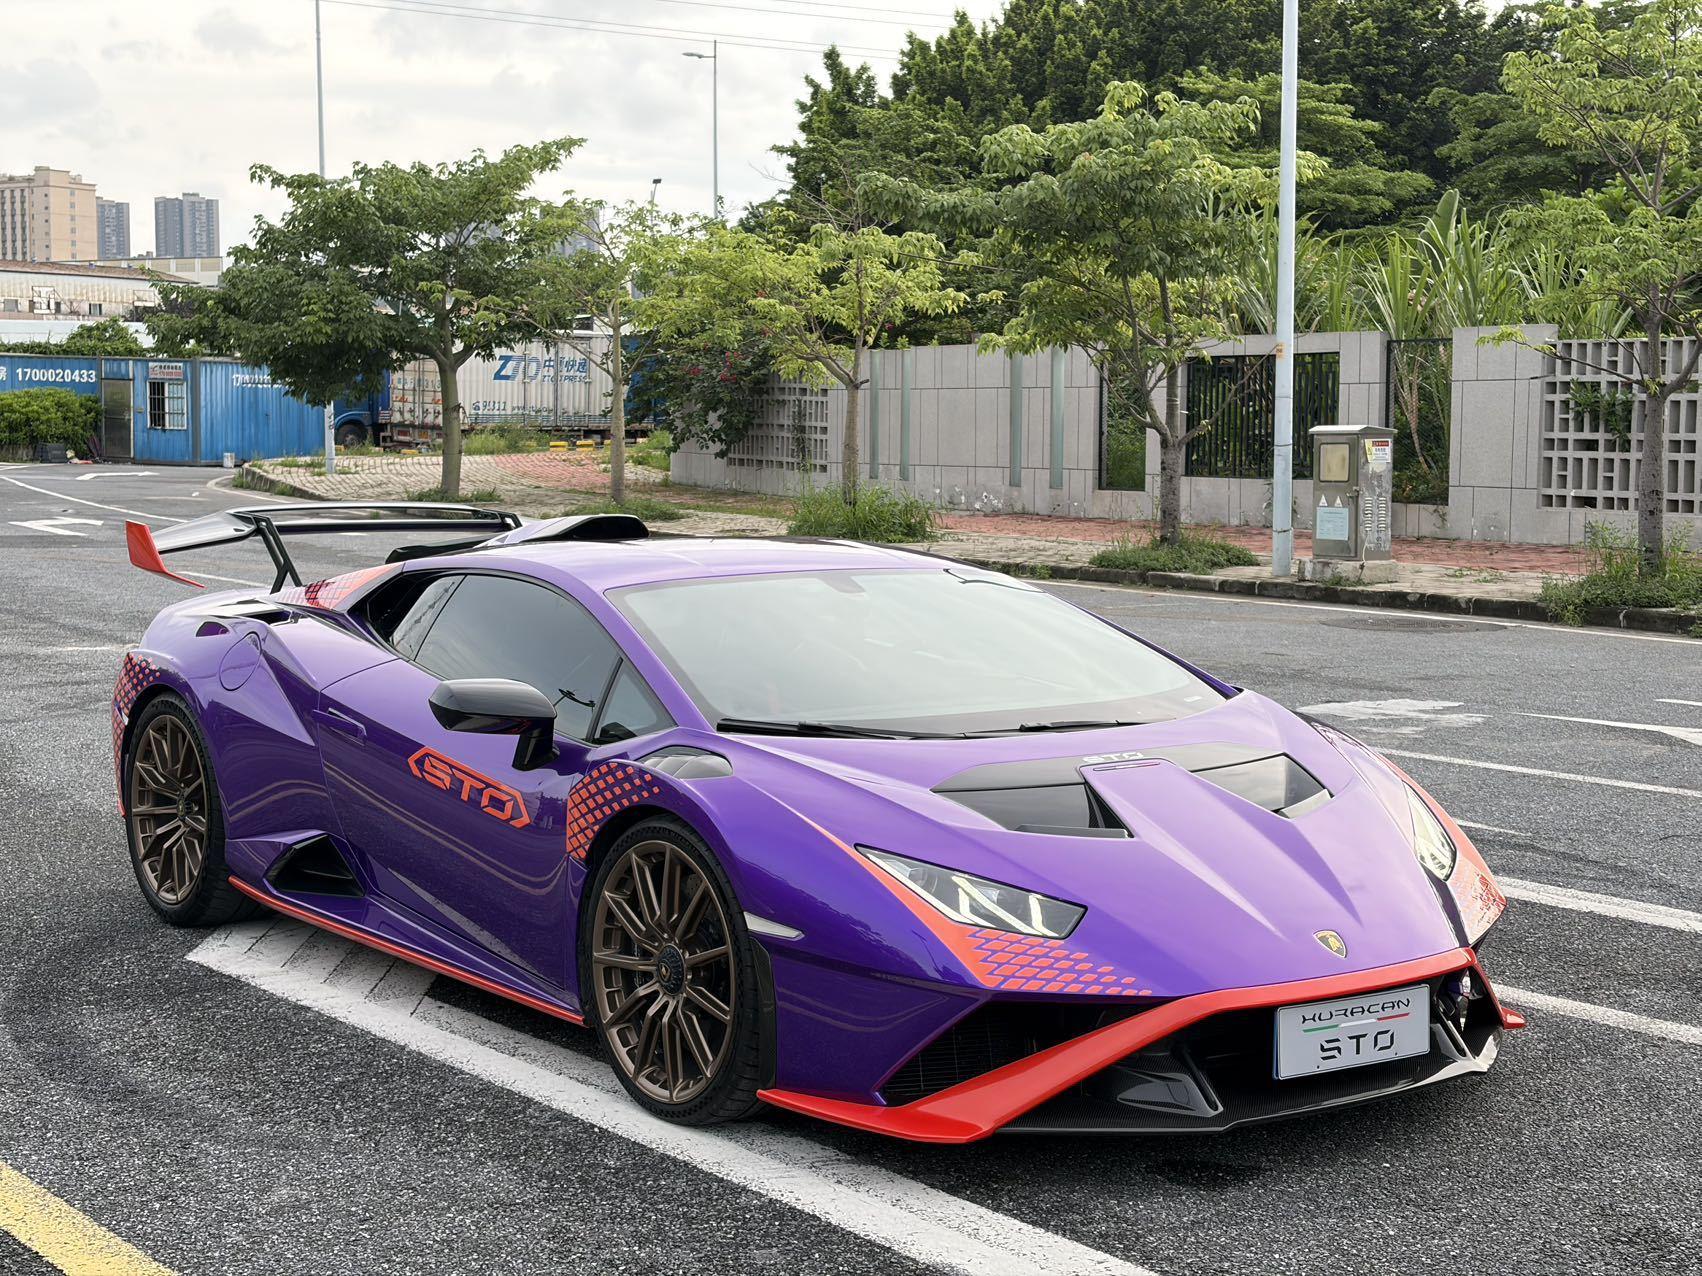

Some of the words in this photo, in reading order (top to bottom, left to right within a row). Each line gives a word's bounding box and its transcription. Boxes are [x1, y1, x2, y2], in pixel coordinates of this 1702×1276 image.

[16, 368, 96, 382] 1700020433
[493, 355, 542, 381] ZTO
[1083, 752, 1144, 762] STO
[423, 757, 513, 820] STO
[1319, 1029, 1395, 1061] STO
